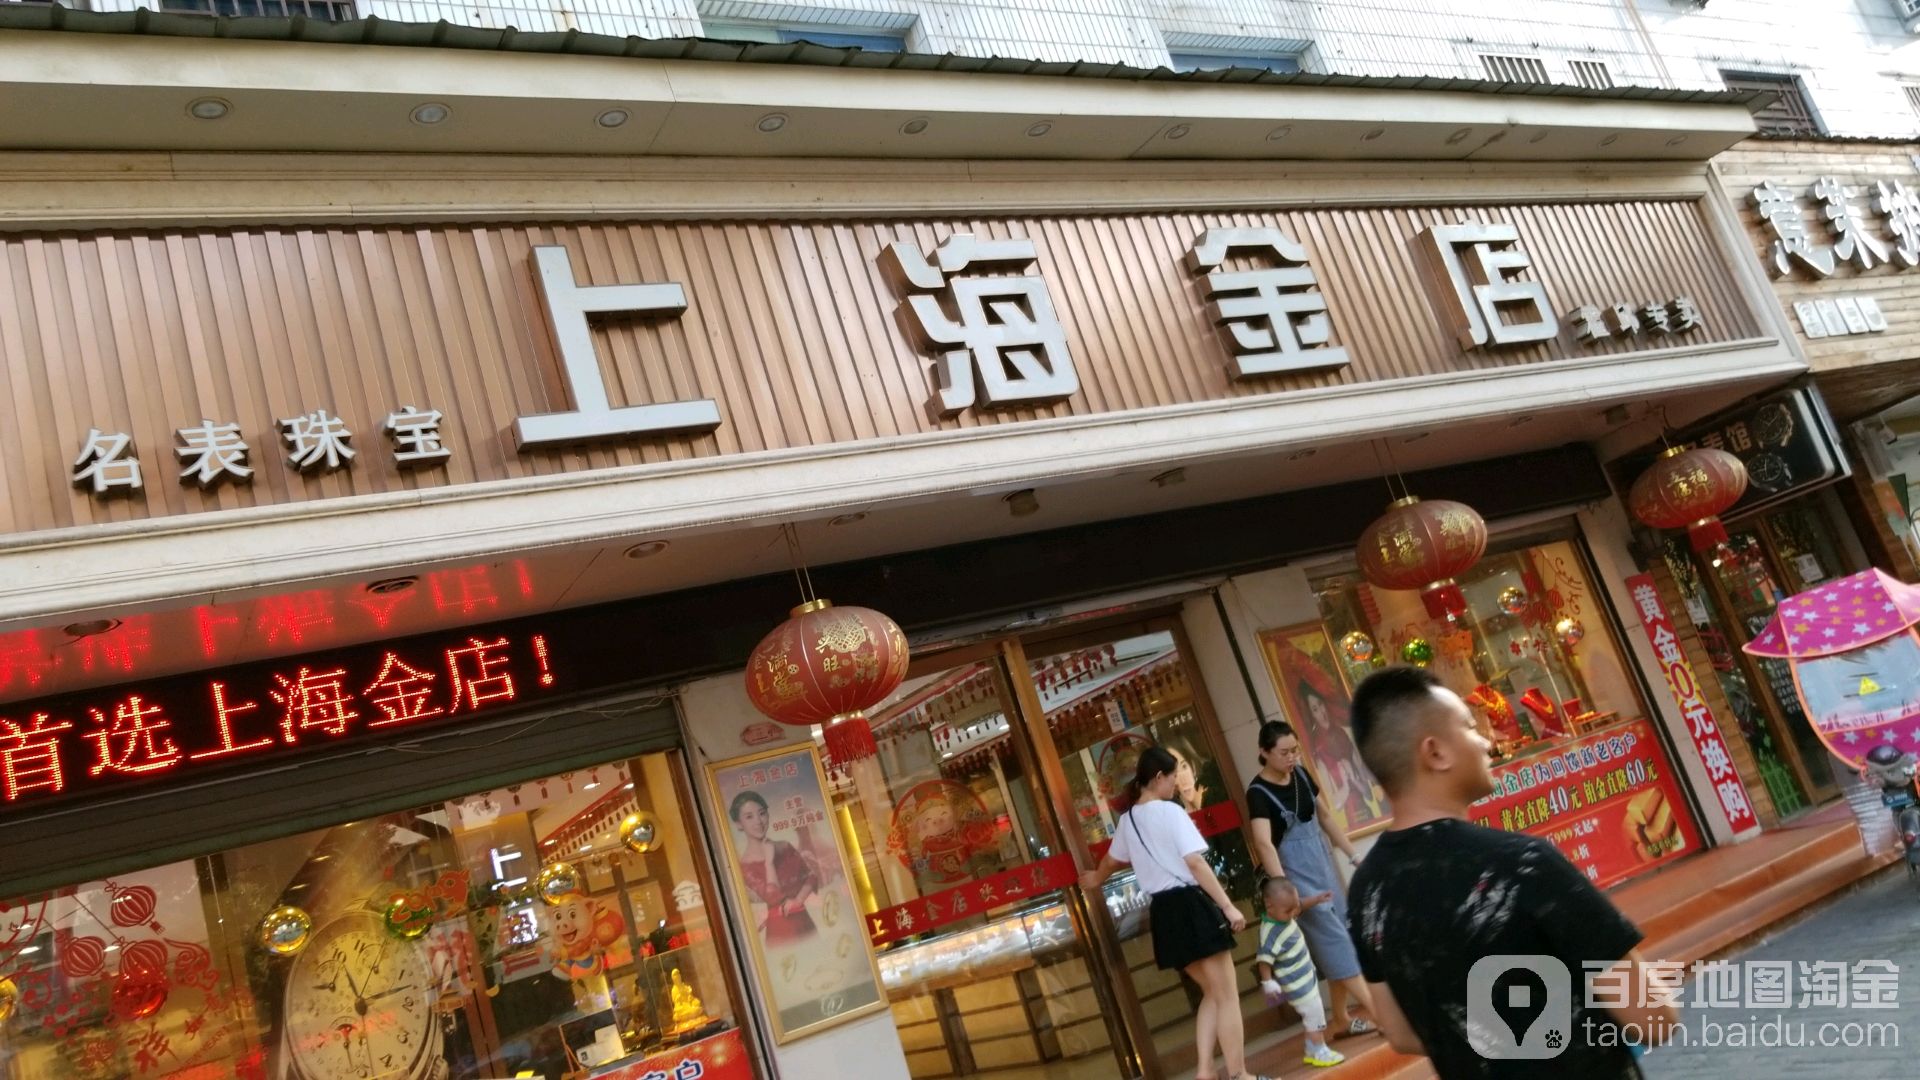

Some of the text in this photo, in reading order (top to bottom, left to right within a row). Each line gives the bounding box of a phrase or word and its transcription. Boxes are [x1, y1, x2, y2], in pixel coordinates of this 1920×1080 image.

[515, 220, 1560, 449] 上海金店
[73, 405, 452, 495] 名表珠宝
[738, 761, 799, 789] 上海金店
[1634, 584, 1752, 824] 黄金0元换购
